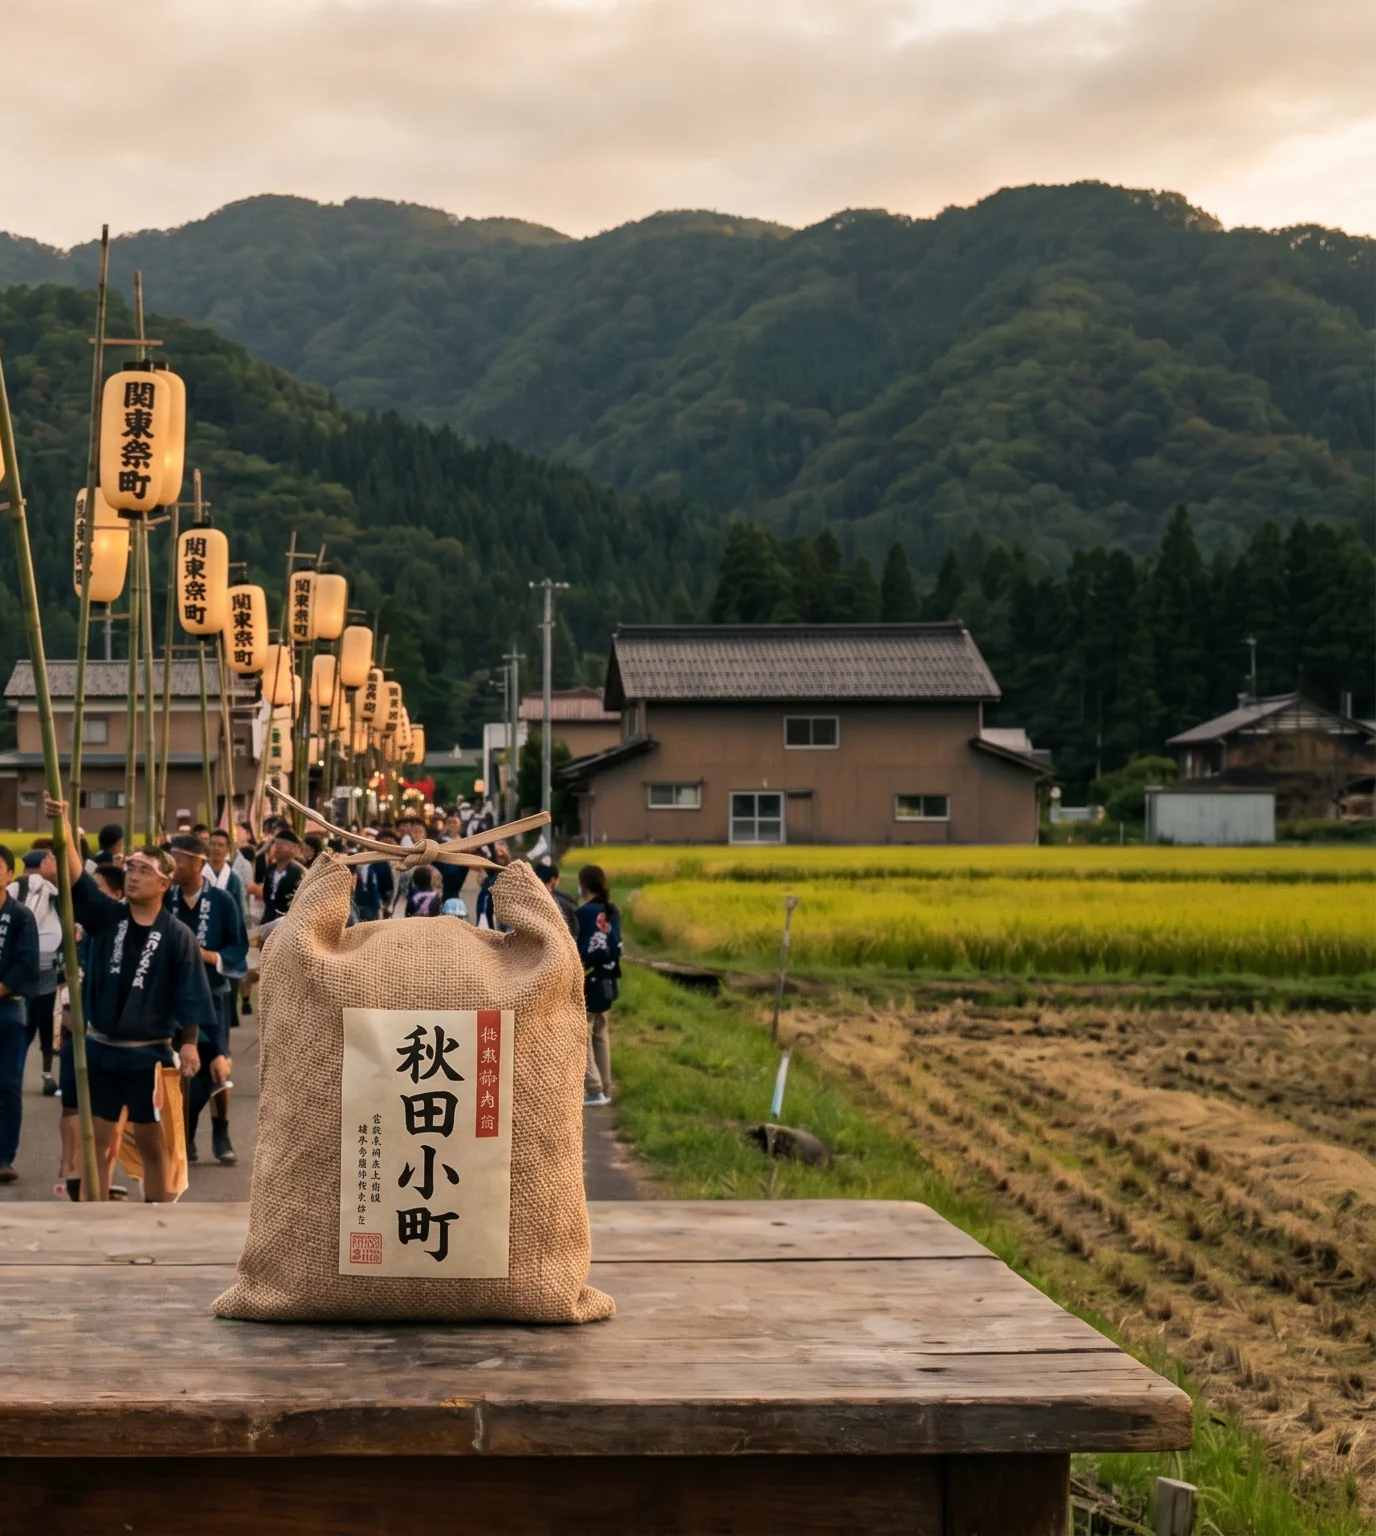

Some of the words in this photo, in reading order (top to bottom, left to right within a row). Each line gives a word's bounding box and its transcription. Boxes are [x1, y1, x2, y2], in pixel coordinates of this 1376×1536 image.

[119, 381, 155, 499] 関東祭町
[396, 1024, 465, 1262] 秋田小町
